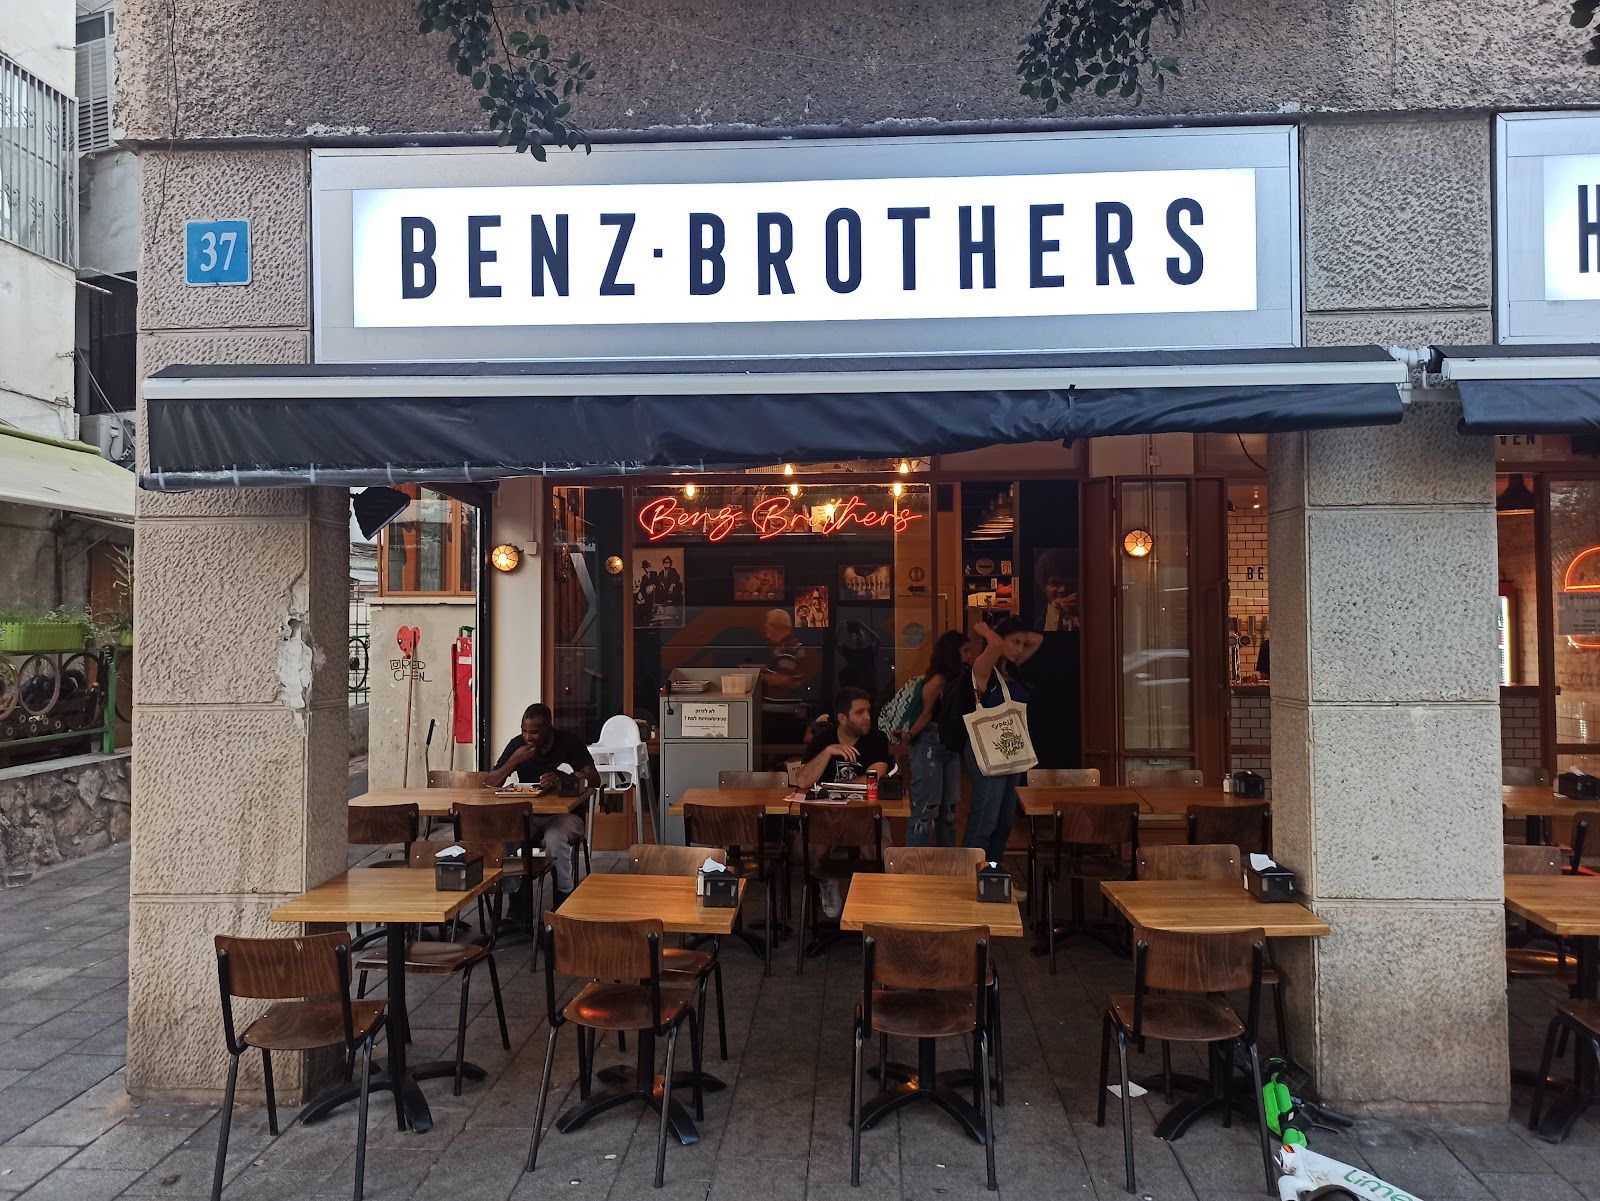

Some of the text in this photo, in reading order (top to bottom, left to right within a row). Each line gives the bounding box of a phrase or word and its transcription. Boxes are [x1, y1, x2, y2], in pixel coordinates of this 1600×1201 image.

[200, 231, 238, 272] 37
[689, 197, 1204, 296] BROTHERS
[639, 496, 922, 541] Benz Brothers
[1246, 566, 1264, 580] BE
